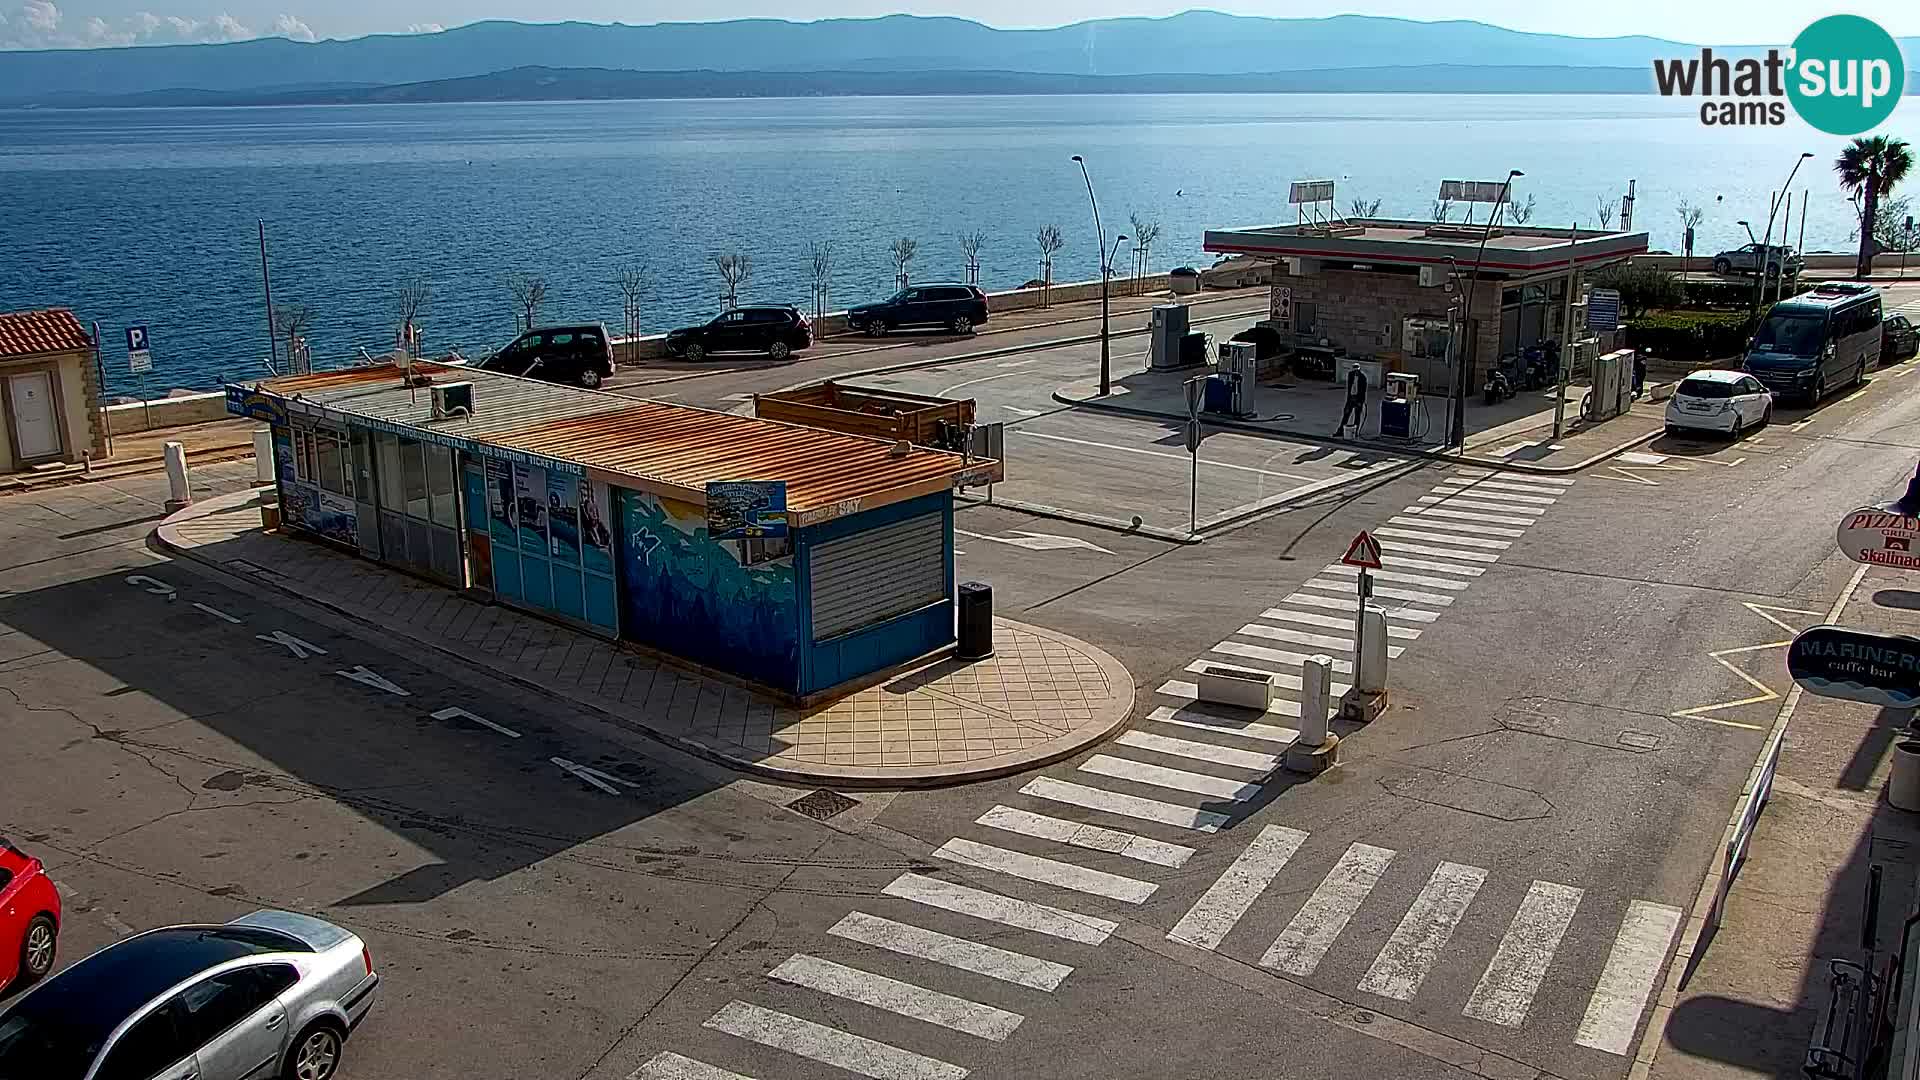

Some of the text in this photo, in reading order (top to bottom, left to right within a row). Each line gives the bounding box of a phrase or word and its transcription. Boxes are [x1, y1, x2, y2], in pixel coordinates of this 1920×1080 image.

[130, 329, 143, 348] P
[437, 435, 468, 450] POSTAJA
[494, 448, 526, 464] STATION
[528, 455, 554, 470] TICKET
[555, 461, 583, 476] OFFICE
[1847, 513, 1920, 532] PIZZE
[1880, 529, 1918, 540] GRILL
[1870, 664, 1897, 679] bar
